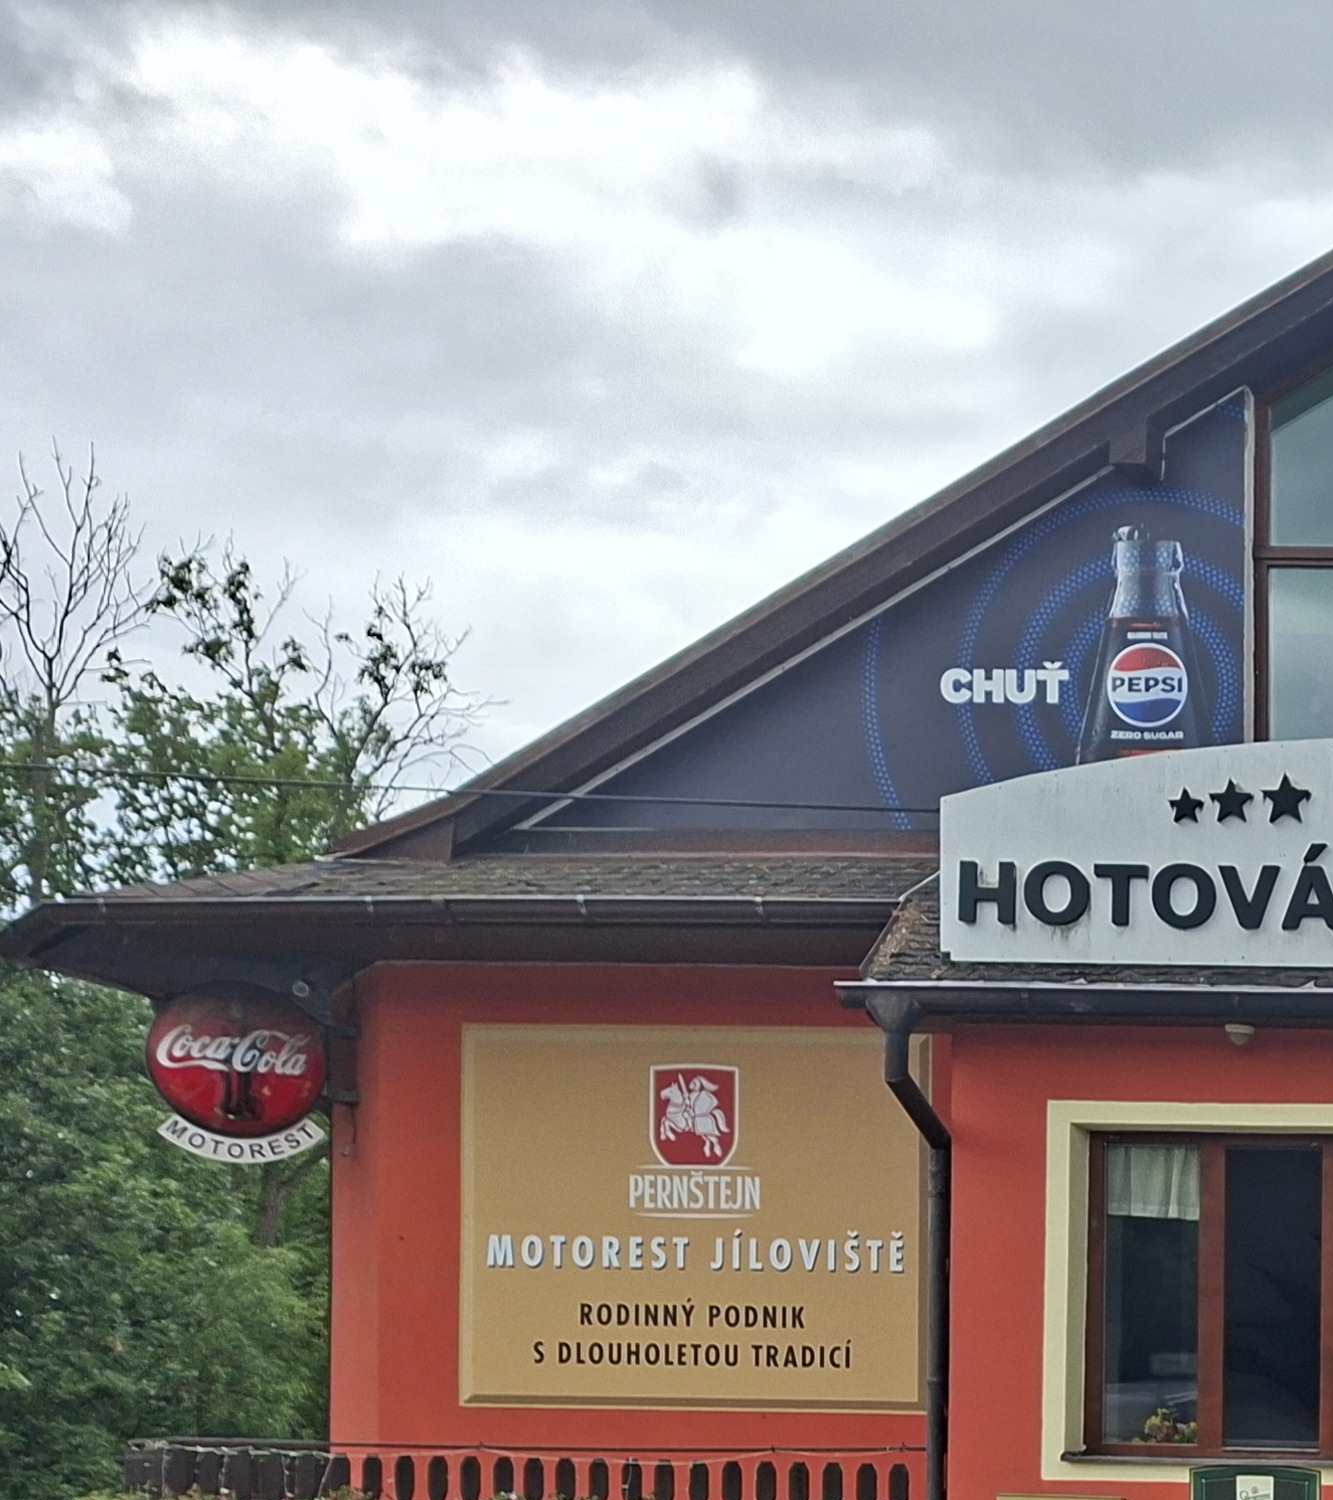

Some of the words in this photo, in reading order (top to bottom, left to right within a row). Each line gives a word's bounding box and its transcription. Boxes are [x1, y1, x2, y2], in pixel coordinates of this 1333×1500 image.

[940, 661, 1069, 703] CHUŤ
[1111, 676, 1183, 693] PEPSI
[1110, 730, 1142, 740] ZERO
[1143, 730, 1184, 740] SUGAR
[156, 1024, 310, 1076] Coca-Cola
[165, 1119, 315, 1160] MOTOREST
[629, 1171, 760, 1210] PERNŠTEJN
[487, 1234, 690, 1270] MOTOREST
[710, 1228, 905, 1273] JÍLOVIŠTĚ
[579, 1298, 695, 1328] RODINNÝ
[708, 1305, 806, 1330] PODNIK
[533, 1341, 545, 1364] S
[558, 1342, 739, 1367] DLOUHOLETOU
[752, 1339, 852, 1369] TRADICÍ
